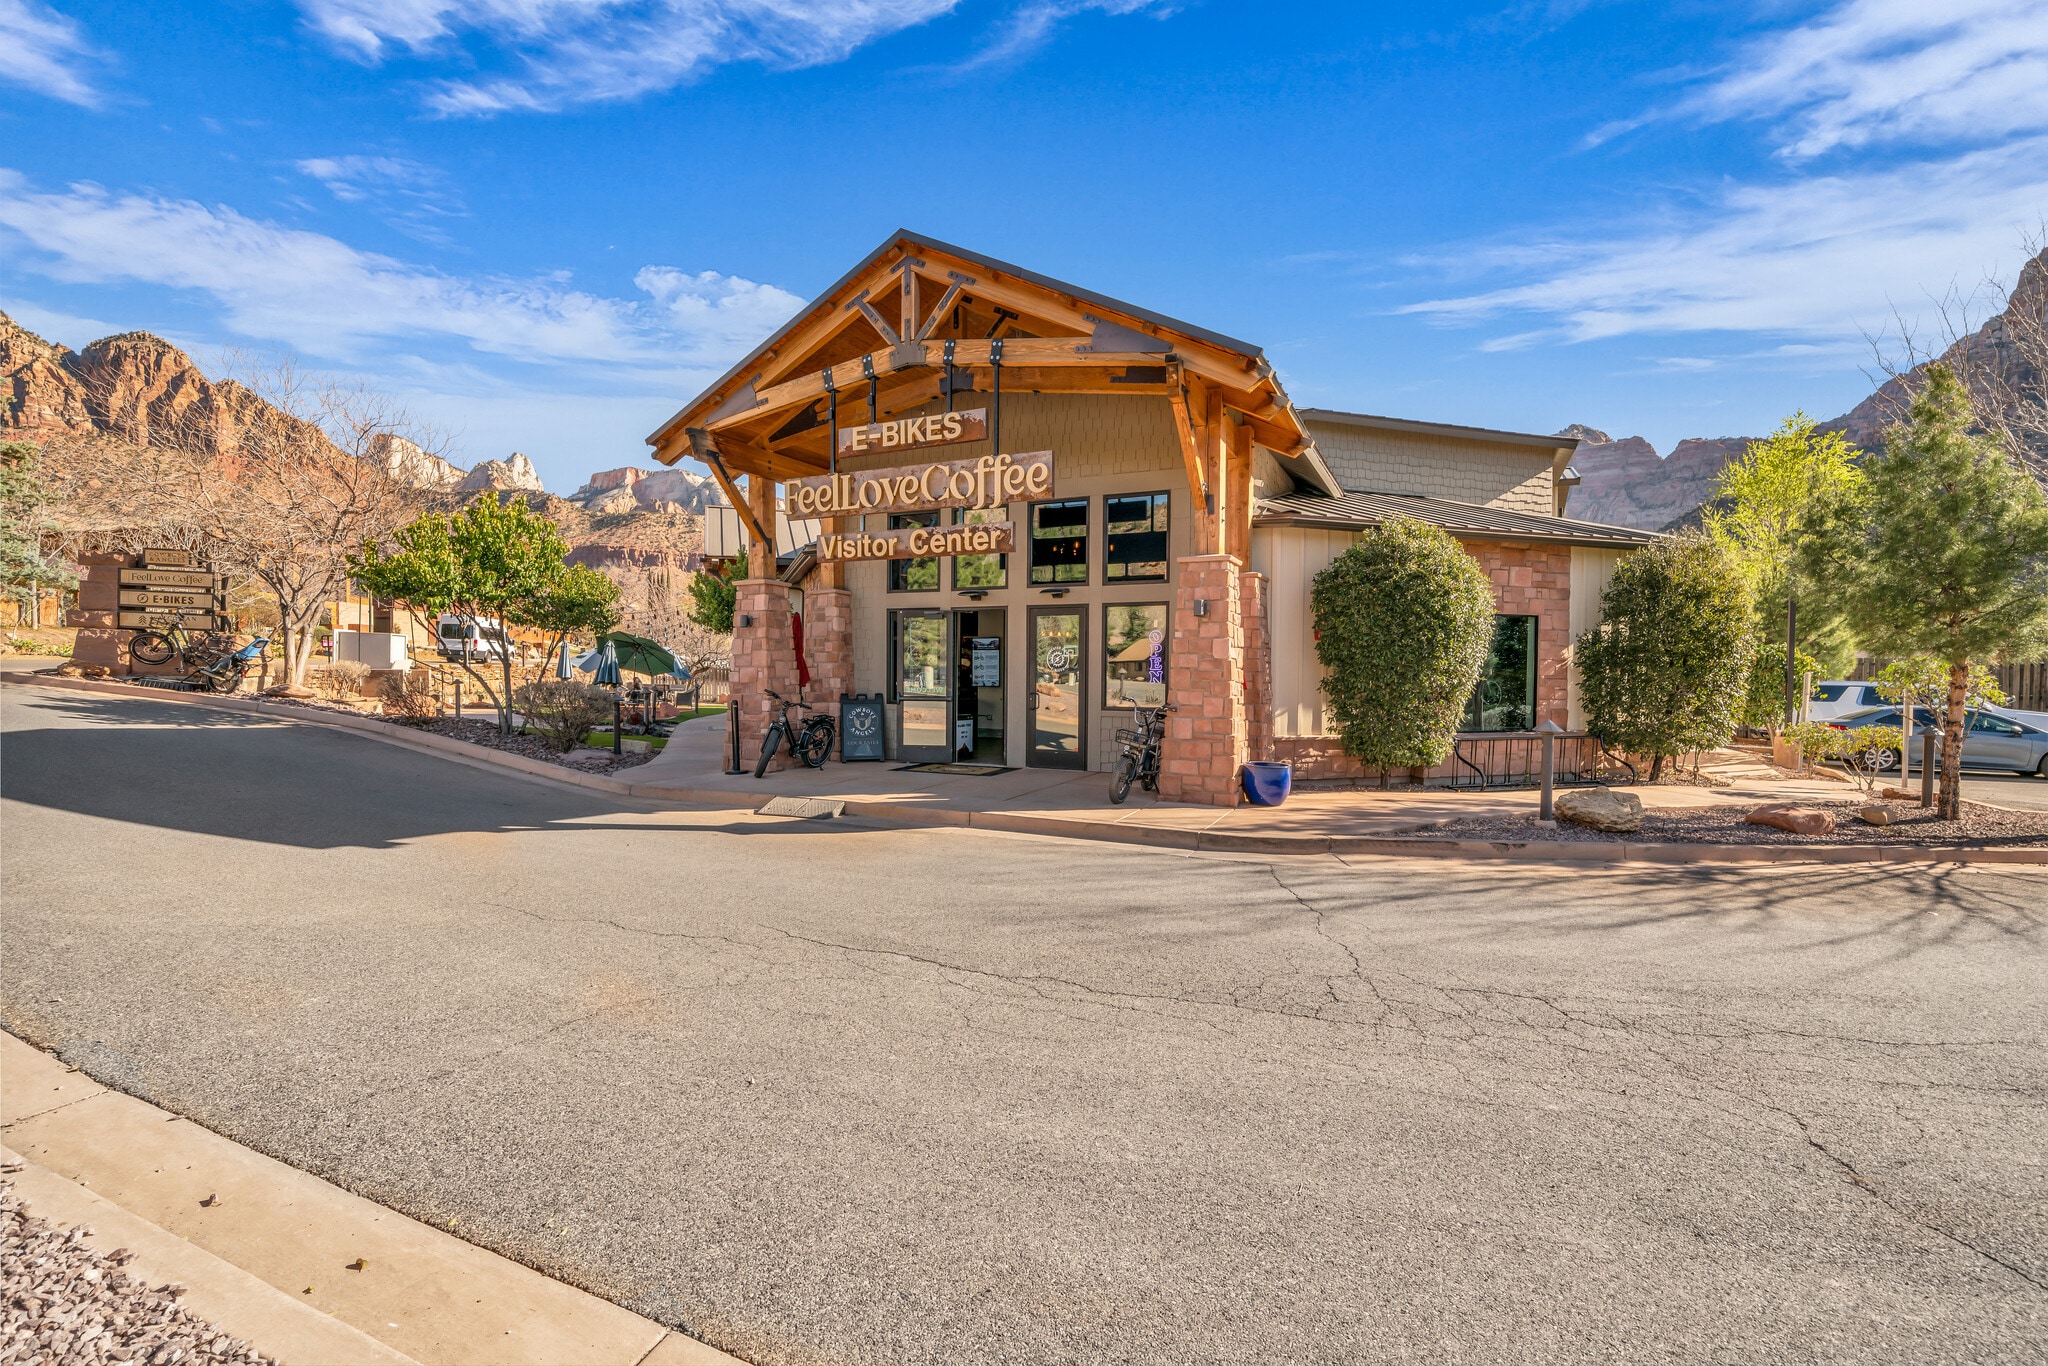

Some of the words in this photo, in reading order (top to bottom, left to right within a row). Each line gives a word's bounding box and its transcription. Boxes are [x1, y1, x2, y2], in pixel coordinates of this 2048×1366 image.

[852, 411, 963, 451] E-BIKES
[820, 534, 899, 560] Visitor
[909, 527, 1002, 554] Center
[131, 572, 171, 582] FeelLove
[173, 575, 203, 585] Coffee
[1149, 630, 1163, 685] OPEN
[849, 707, 877, 719] COWBOYS
[850, 726, 875, 736] ANGELS
